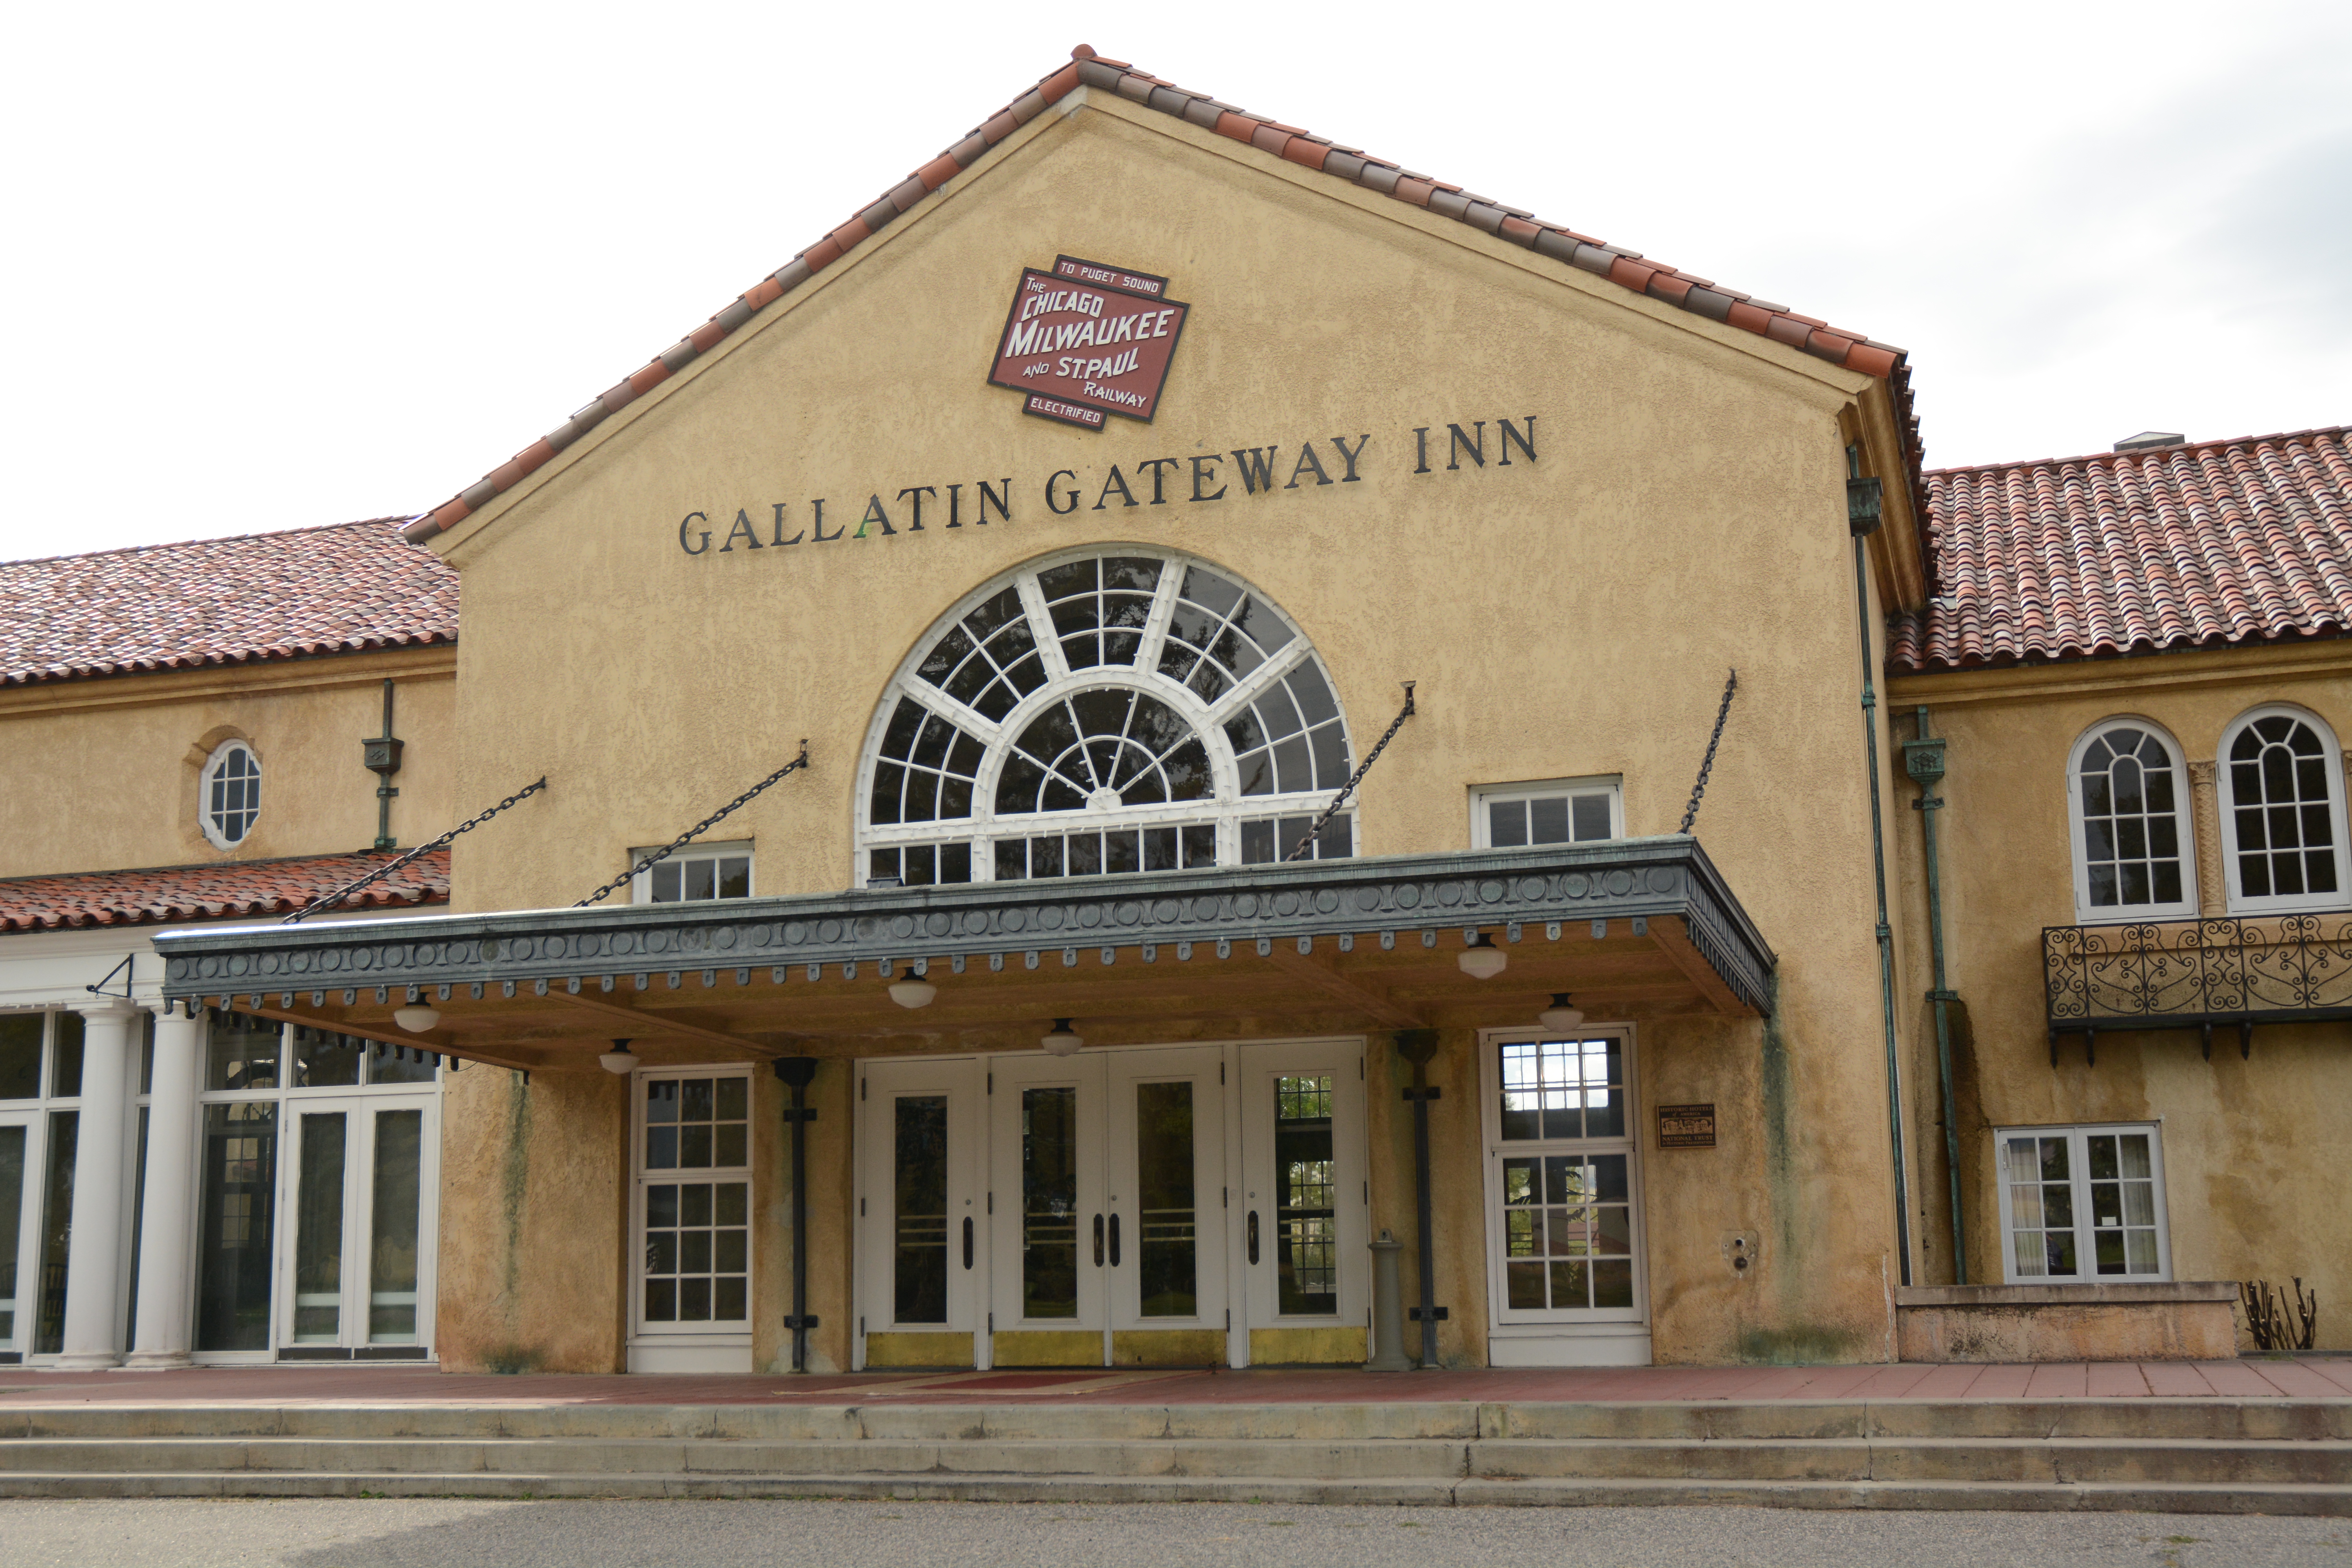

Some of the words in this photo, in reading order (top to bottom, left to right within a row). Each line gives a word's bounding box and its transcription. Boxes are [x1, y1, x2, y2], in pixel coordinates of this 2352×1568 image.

[1025, 277, 1046, 293] THE
[1061, 262, 1075, 274] TO
[1080, 267, 1117, 283] PUGET
[1122, 276, 1159, 293] SOUND
[1021, 291, 1104, 322] CHICAGO
[1005, 309, 1175, 358] MILWAUKEE
[1023, 361, 1049, 378] AND
[1083, 381, 1147, 408] RAILWAY
[1030, 397, 1100, 423] ELECTRIFIED
[679, 477, 1012, 556] GALLATIN
[1045, 434, 1371, 515] GATEWAY
[1412, 416, 1538, 474] INN
